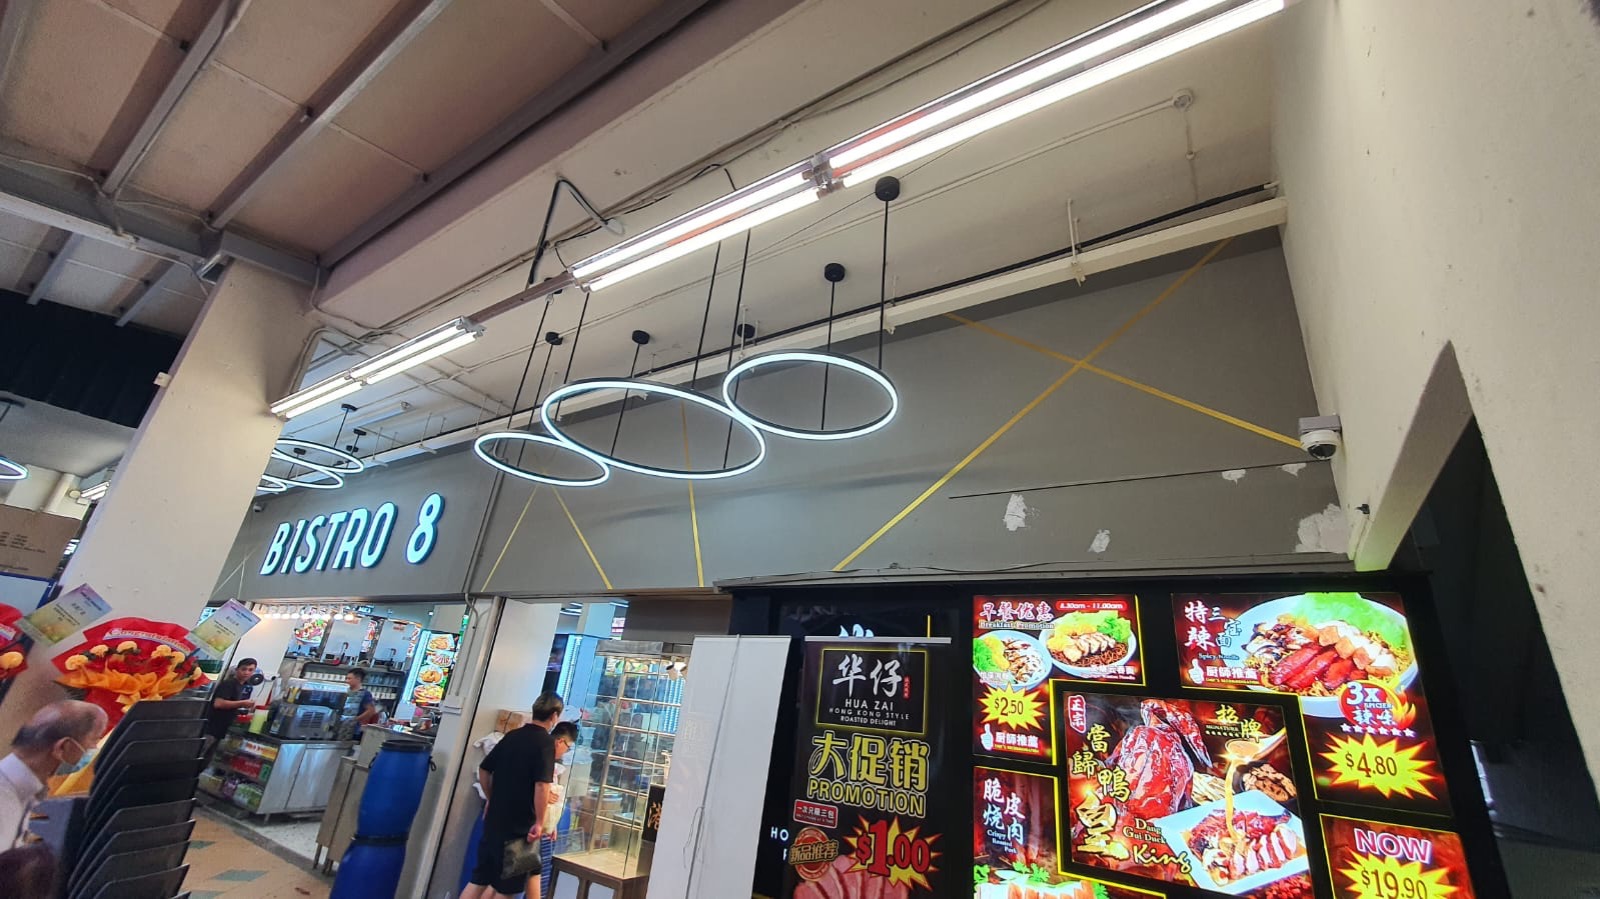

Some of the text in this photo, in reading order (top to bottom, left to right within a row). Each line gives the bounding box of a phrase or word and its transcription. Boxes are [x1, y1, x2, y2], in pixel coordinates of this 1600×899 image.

[260, 492, 444, 576] BISTRO 8
[979, 620, 1013, 629] Breakfast
[832, 653, 902, 698] 华仔
[829, 707, 910, 720] HONG KONG STYLE
[845, 698, 894, 711] HUA ZAI
[994, 697, 1024, 717] $2.50
[841, 715, 896, 727] ROASTED DELIGHT
[809, 730, 930, 792] 大促销
[1345, 752, 1397, 779] $4.80
[808, 778, 927, 817] PROMOTION
[1122, 826, 1167, 844] Gui Duck
[1134, 817, 1162, 834] Dang
[855, 819, 930, 876] $1.00
[1133, 843, 1192, 874] King
[1353, 827, 1432, 864] NOW
[1361, 868, 1428, 899] $19.90
